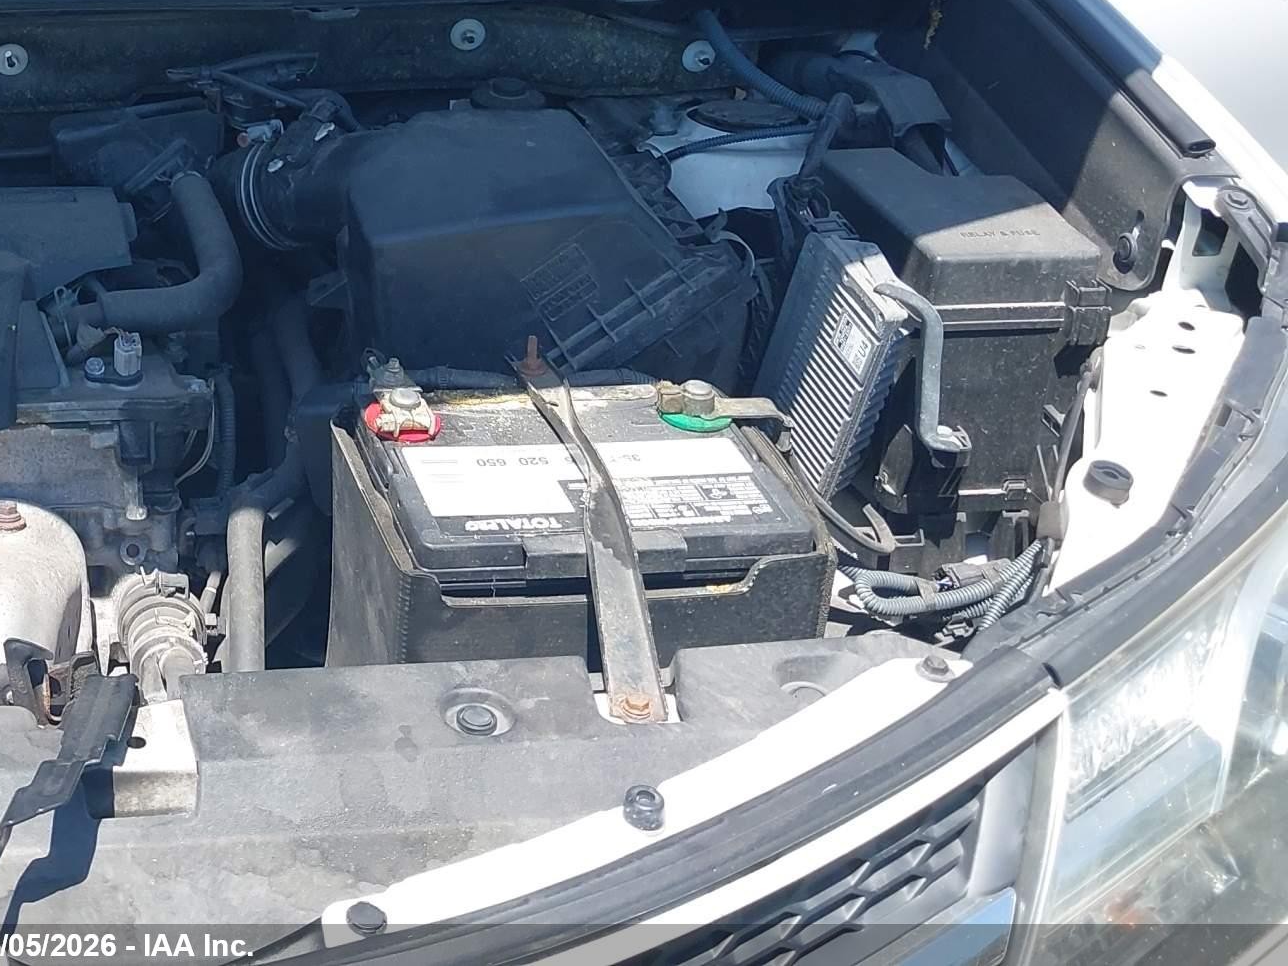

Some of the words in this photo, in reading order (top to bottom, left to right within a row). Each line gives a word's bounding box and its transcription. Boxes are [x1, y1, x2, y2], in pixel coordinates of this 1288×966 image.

[960, 230, 996, 239] RELAY
[1011, 228, 1041, 237] FUSE
[475, 458, 507, 467] 650
[519, 456, 549, 466] 520
